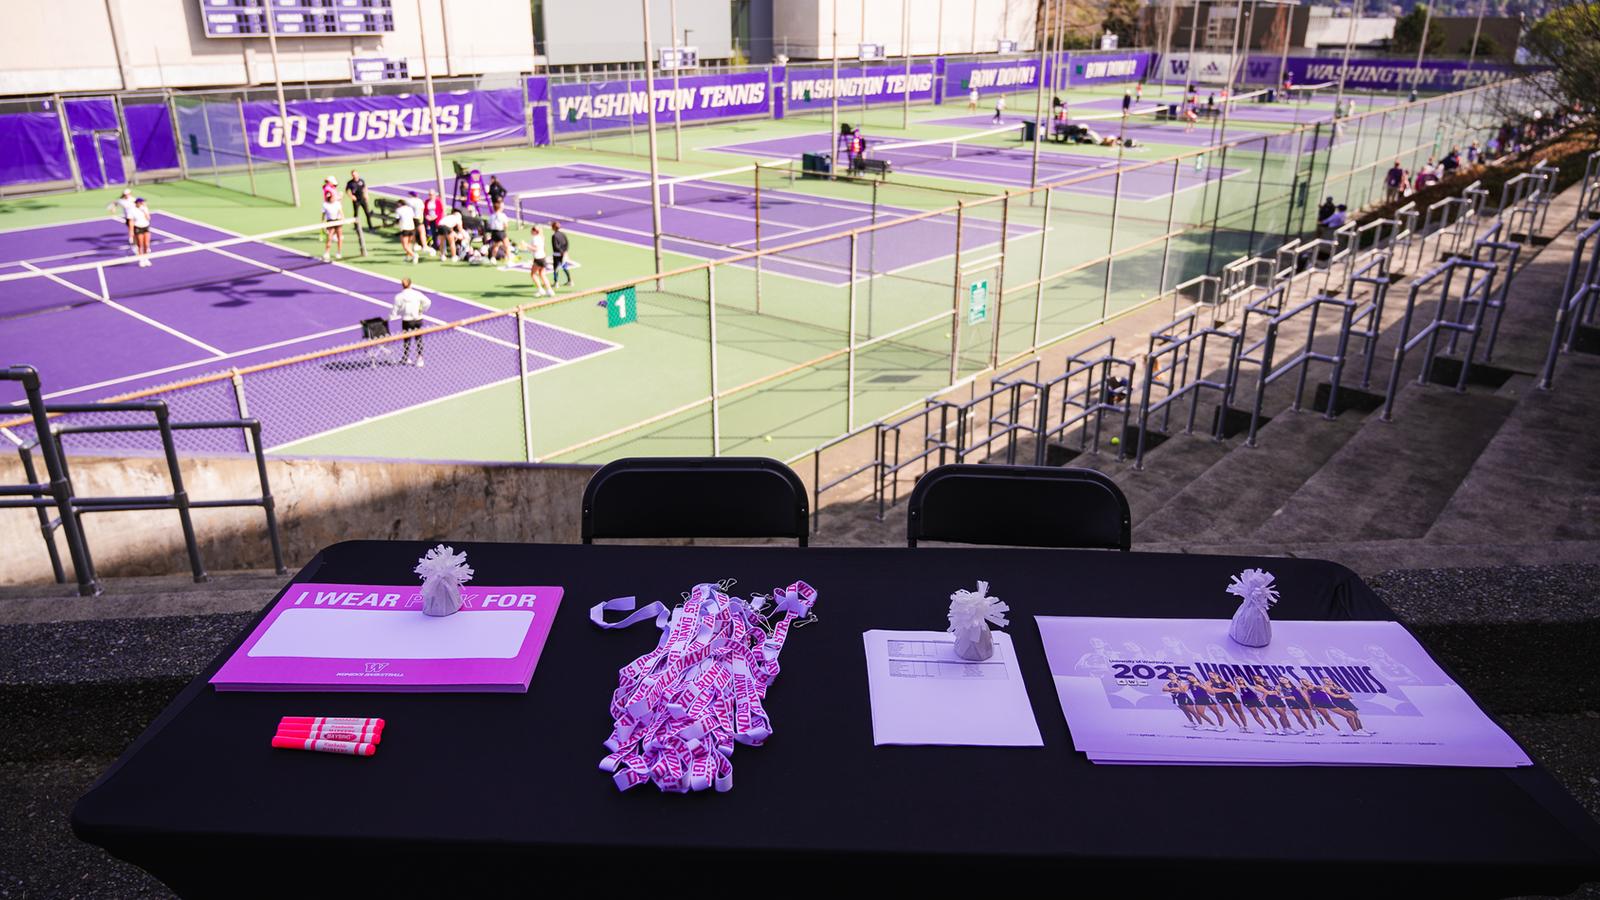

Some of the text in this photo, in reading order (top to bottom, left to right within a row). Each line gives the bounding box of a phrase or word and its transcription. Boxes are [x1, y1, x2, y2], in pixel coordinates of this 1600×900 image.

[697, 82, 765, 109] TENNIS
[257, 114, 309, 148] GO
[614, 294, 627, 319] 1
[294, 592, 537, 608] I WEAR PK FOR
[734, 673, 751, 699] DAWG
[1112, 664, 1197, 680] 2025
[1299, 665, 1387, 693] TENNIS
